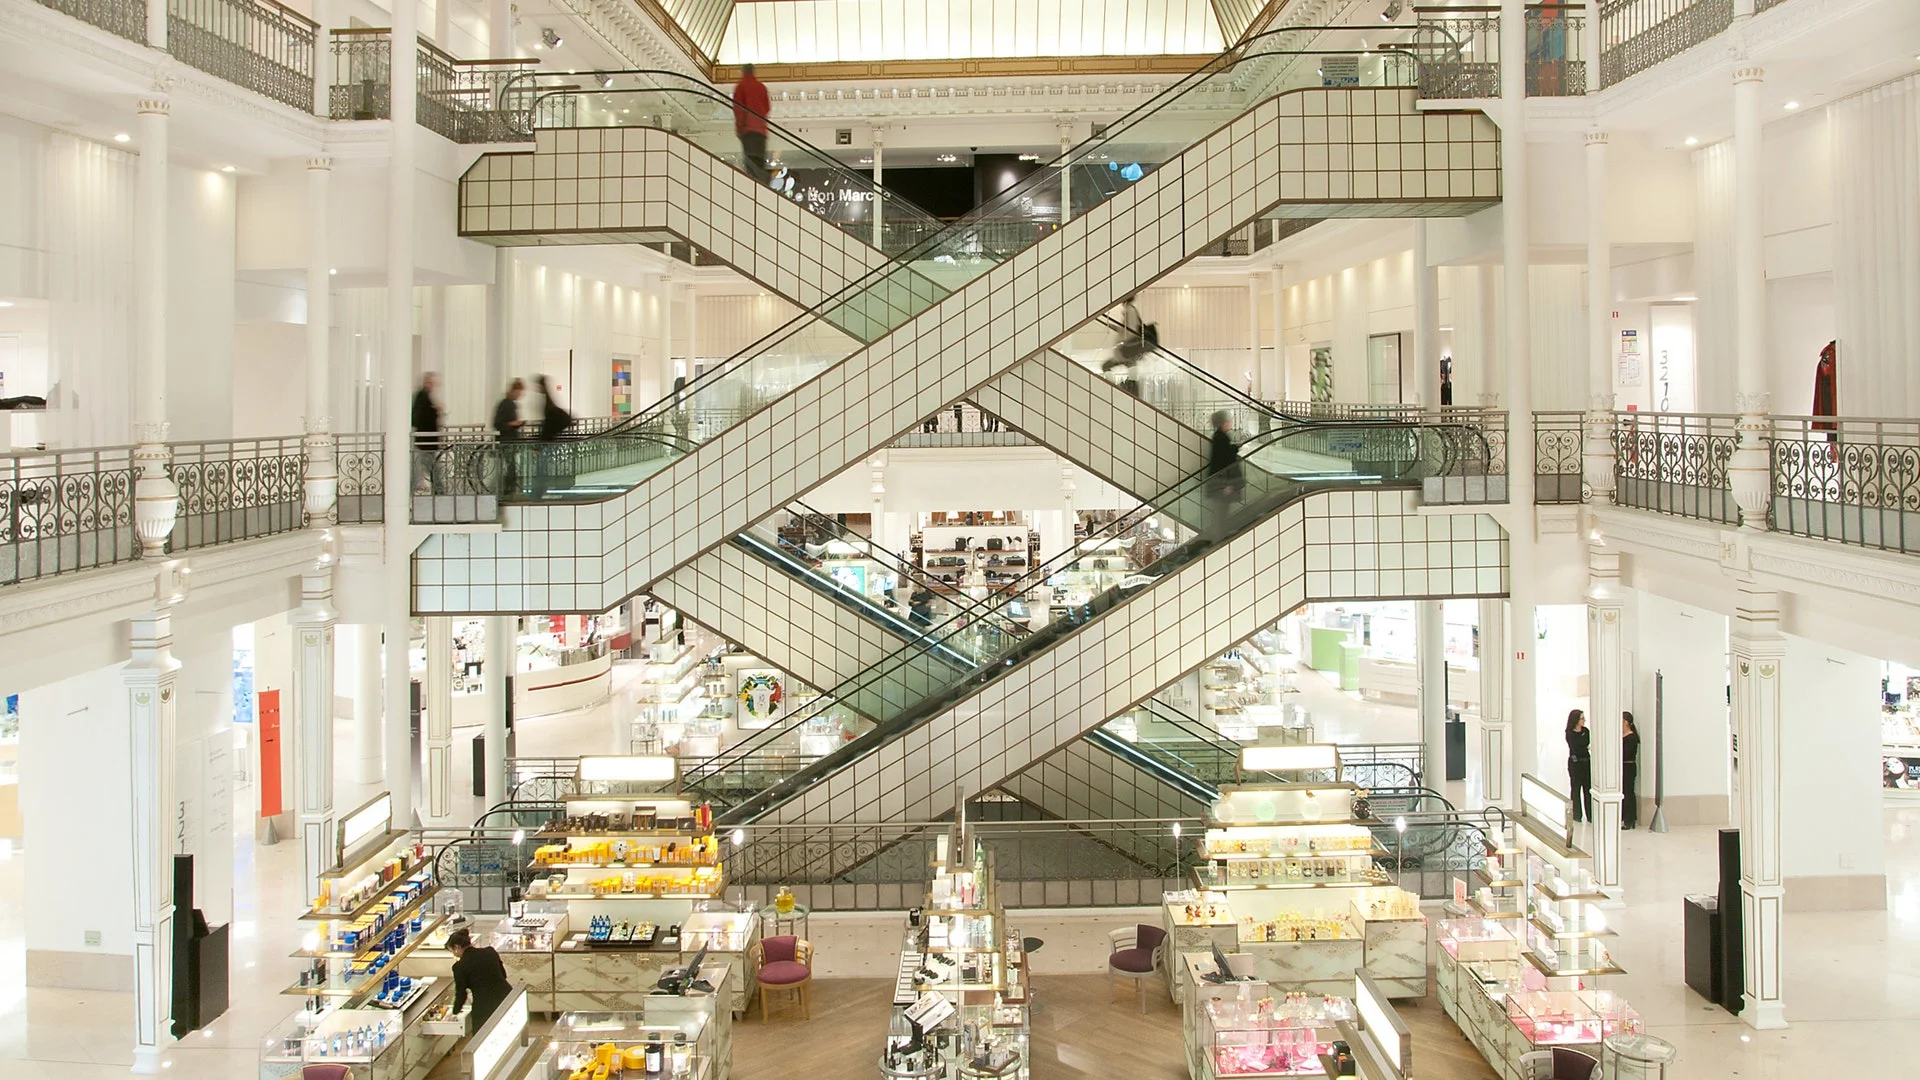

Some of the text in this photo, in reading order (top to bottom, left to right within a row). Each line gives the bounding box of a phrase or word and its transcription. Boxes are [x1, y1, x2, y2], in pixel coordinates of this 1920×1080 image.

[1660, 350, 1668, 365] 3
[1660, 366, 1668, 381] 2
[1664, 382, 1668, 397] 1
[1661, 397, 1669, 412] 0
[178, 801, 185, 820] 3
[178, 820, 185, 839] 2
[180, 839, 185, 855] 1
